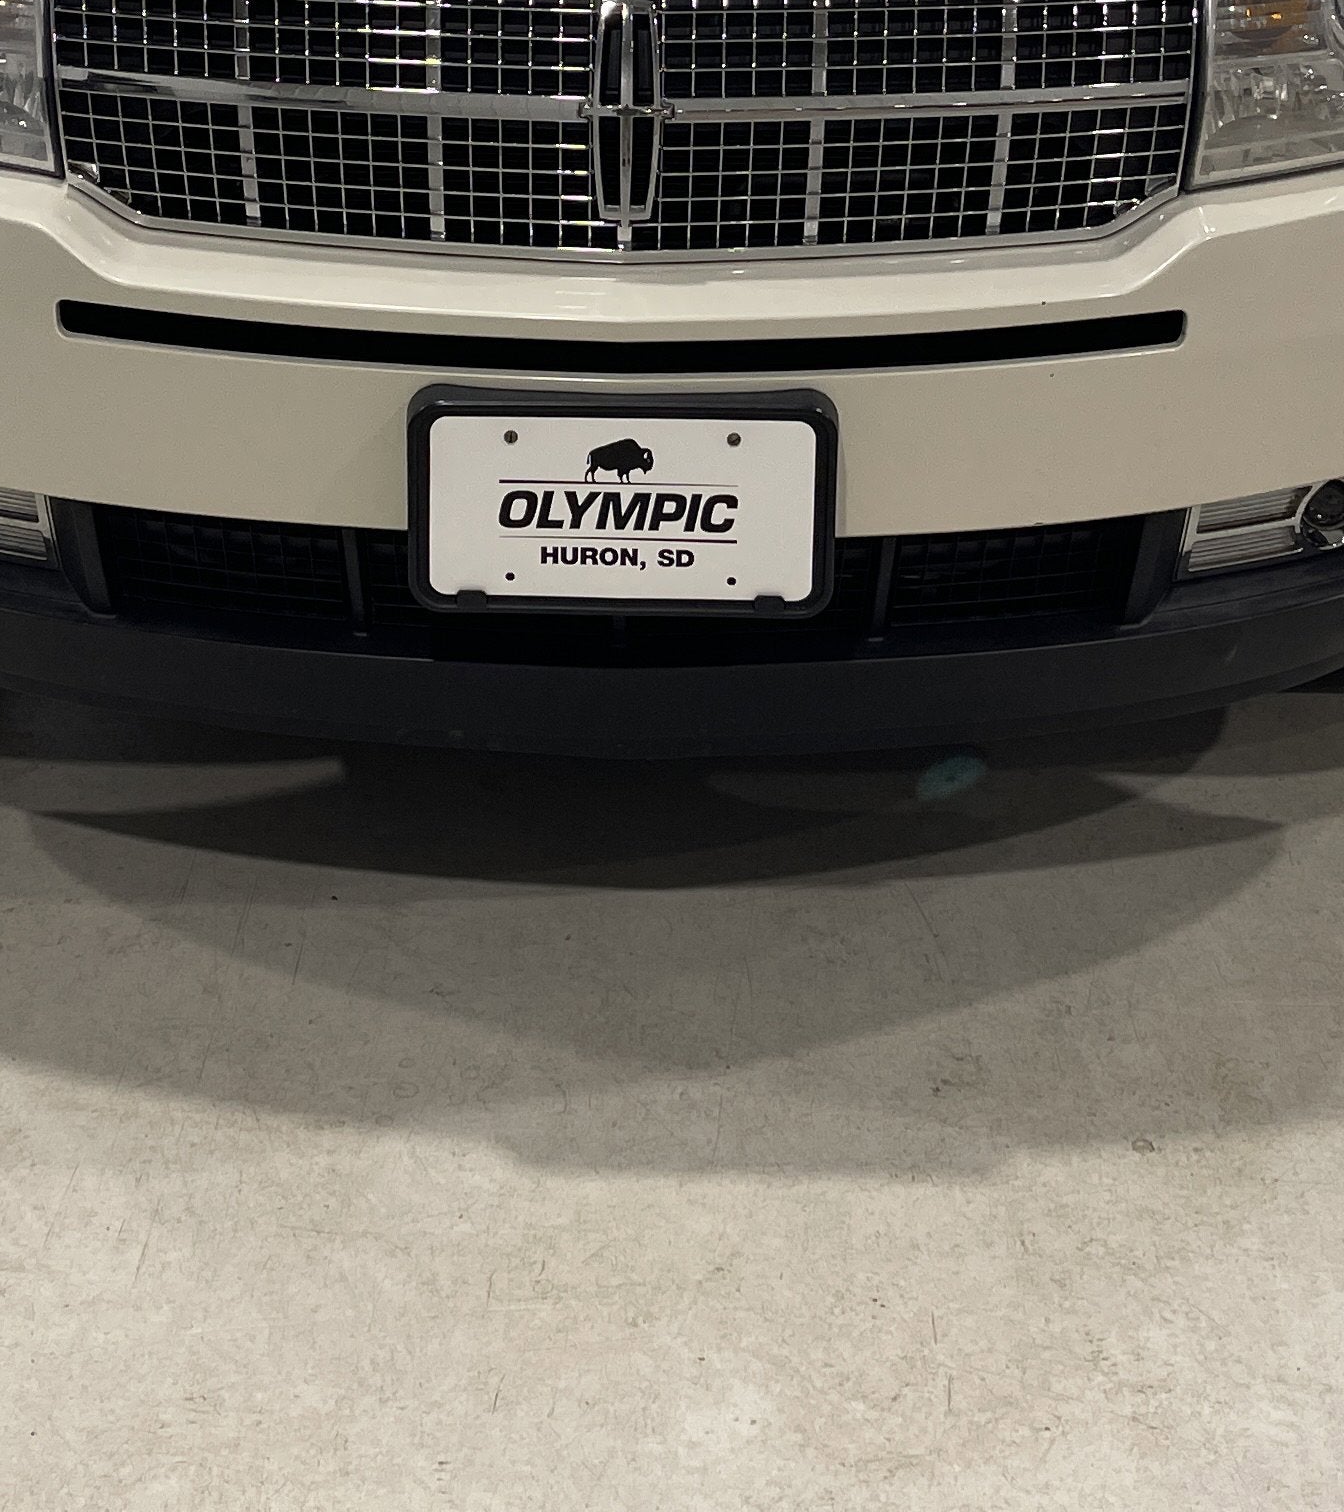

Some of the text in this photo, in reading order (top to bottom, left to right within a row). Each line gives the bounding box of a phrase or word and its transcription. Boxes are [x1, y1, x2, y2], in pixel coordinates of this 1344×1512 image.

[498, 490, 739, 533] OLYMPIC
[540, 546, 695, 570] HURON, SD
